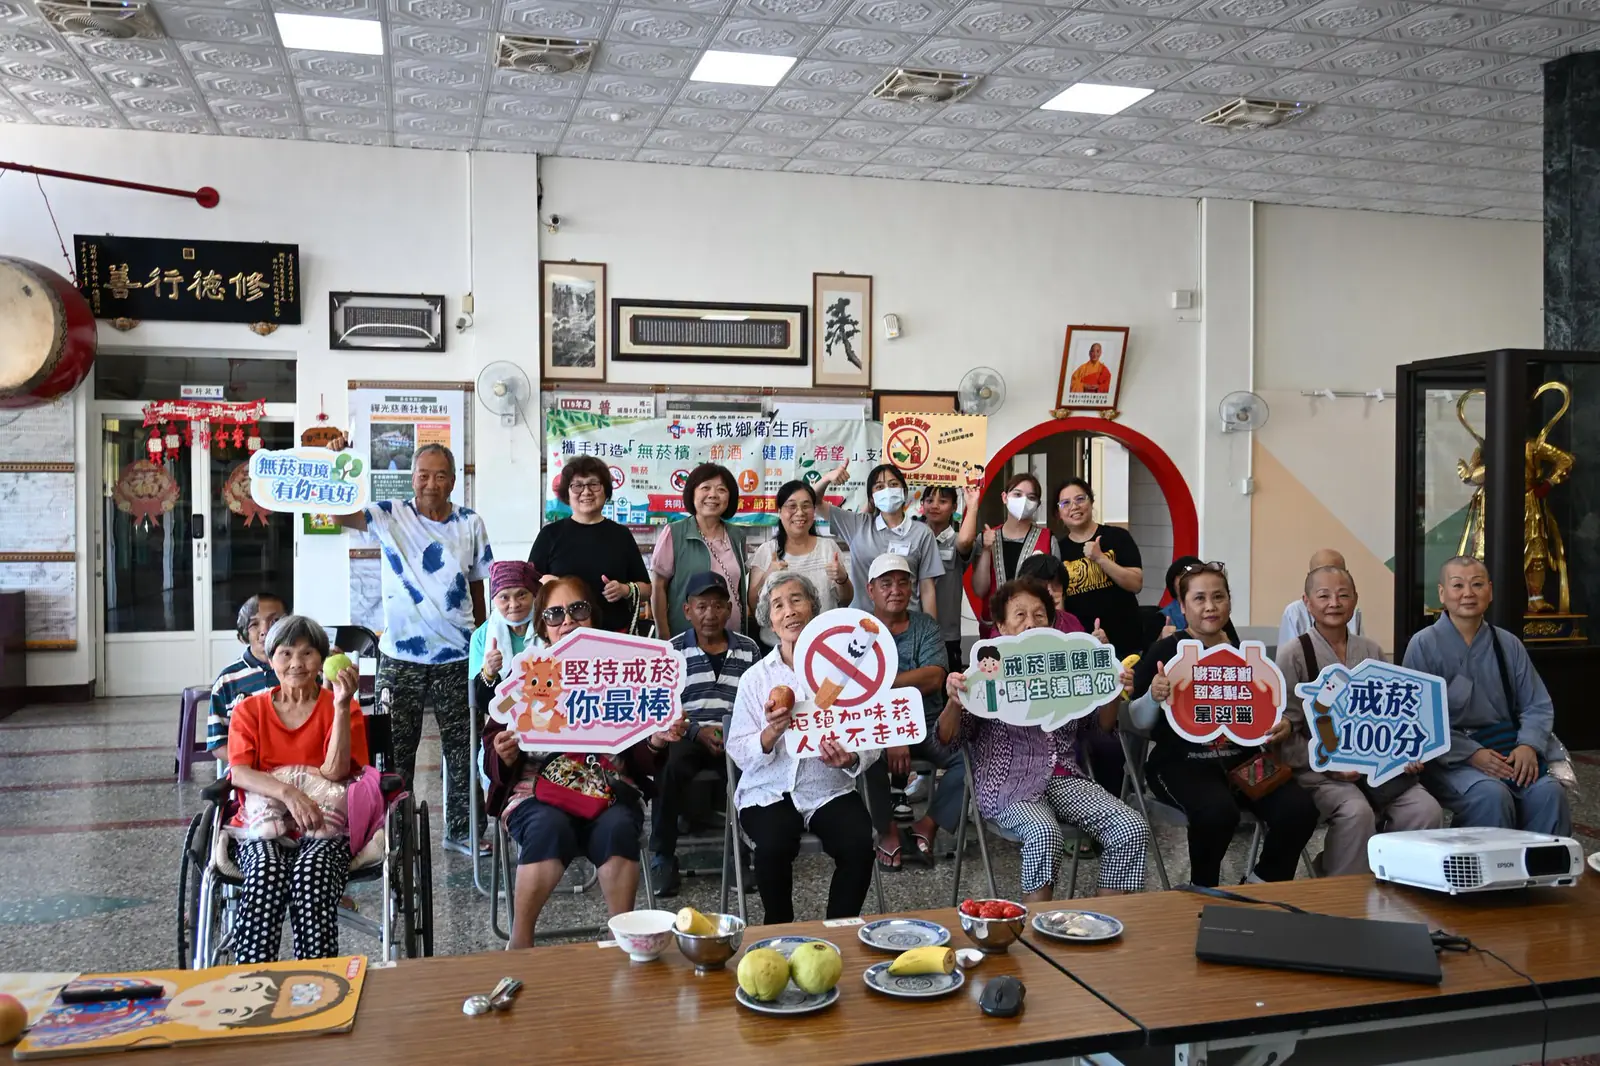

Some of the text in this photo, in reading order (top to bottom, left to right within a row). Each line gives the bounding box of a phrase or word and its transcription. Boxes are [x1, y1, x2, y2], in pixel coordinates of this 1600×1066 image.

[696, 421, 808, 438] 新城鄉衛生所
[259, 457, 329, 478] 無菸環境
[275, 479, 355, 502] 有你真好
[564, 658, 677, 685] 堅持戒菸
[1004, 649, 1112, 677] 戒菸護健康
[1006, 673, 1116, 702] 醫生遠離你
[1349, 680, 1420, 718] 戒菸
[565, 687, 671, 724] 你最棒
[789, 698, 911, 732] 拒絕加味菸
[1341, 722, 1427, 757] 100分
